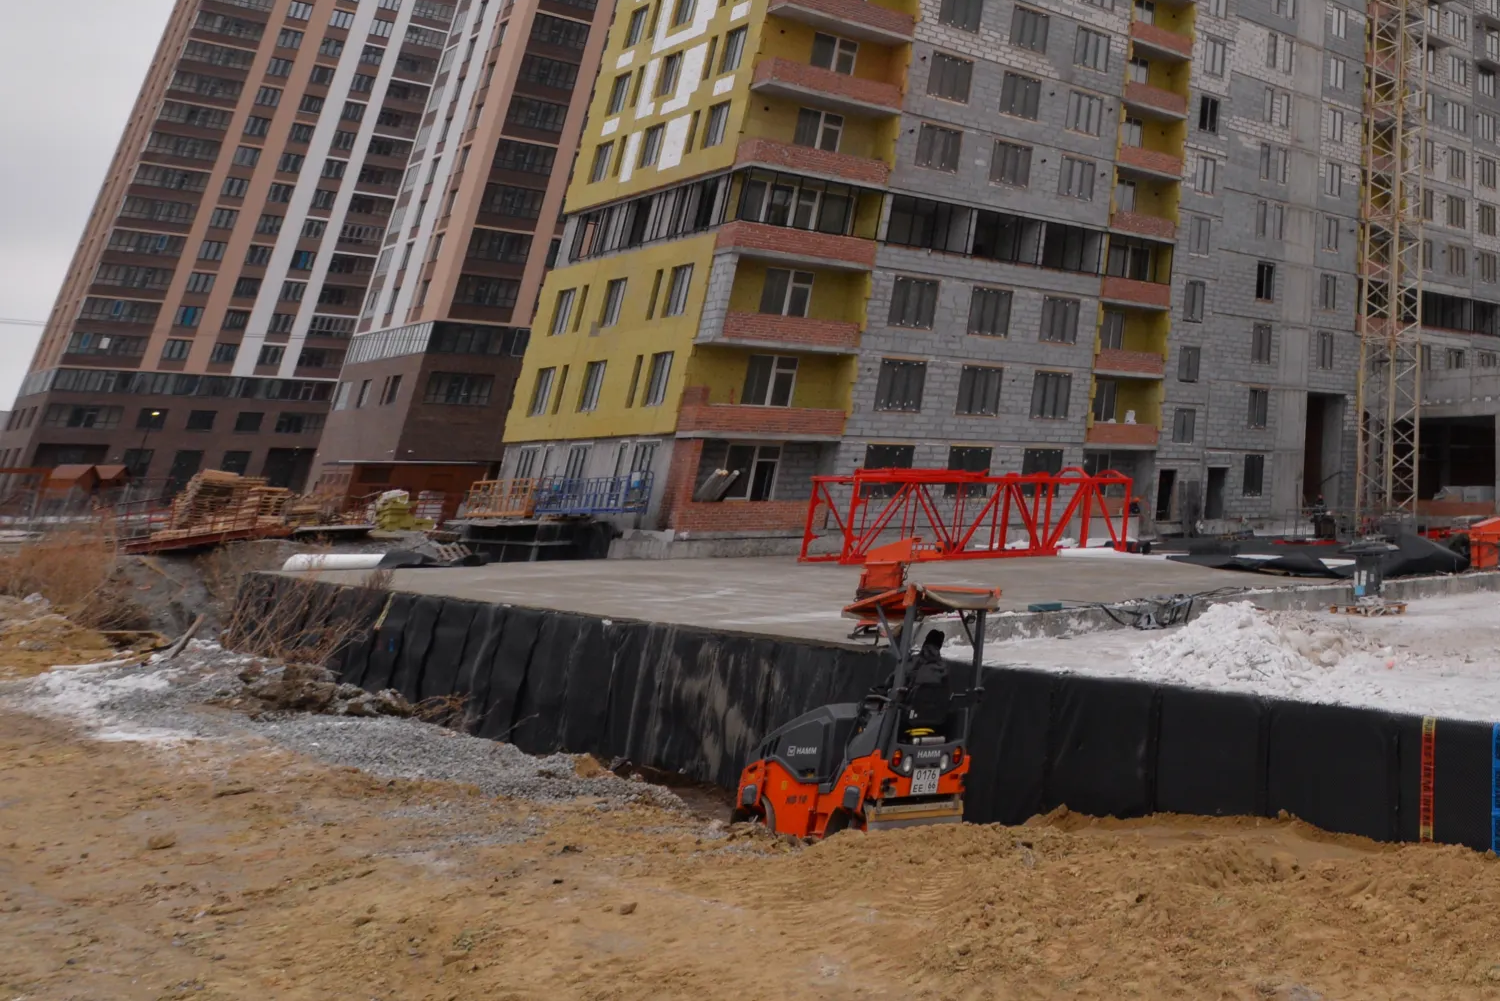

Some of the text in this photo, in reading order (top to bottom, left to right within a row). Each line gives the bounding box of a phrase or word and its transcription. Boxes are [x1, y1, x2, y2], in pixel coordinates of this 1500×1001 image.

[796, 746, 817, 755] HAMM
[917, 749, 941, 758] HAMM
[916, 769, 937, 781] 0176
[927, 781, 936, 790] 66
